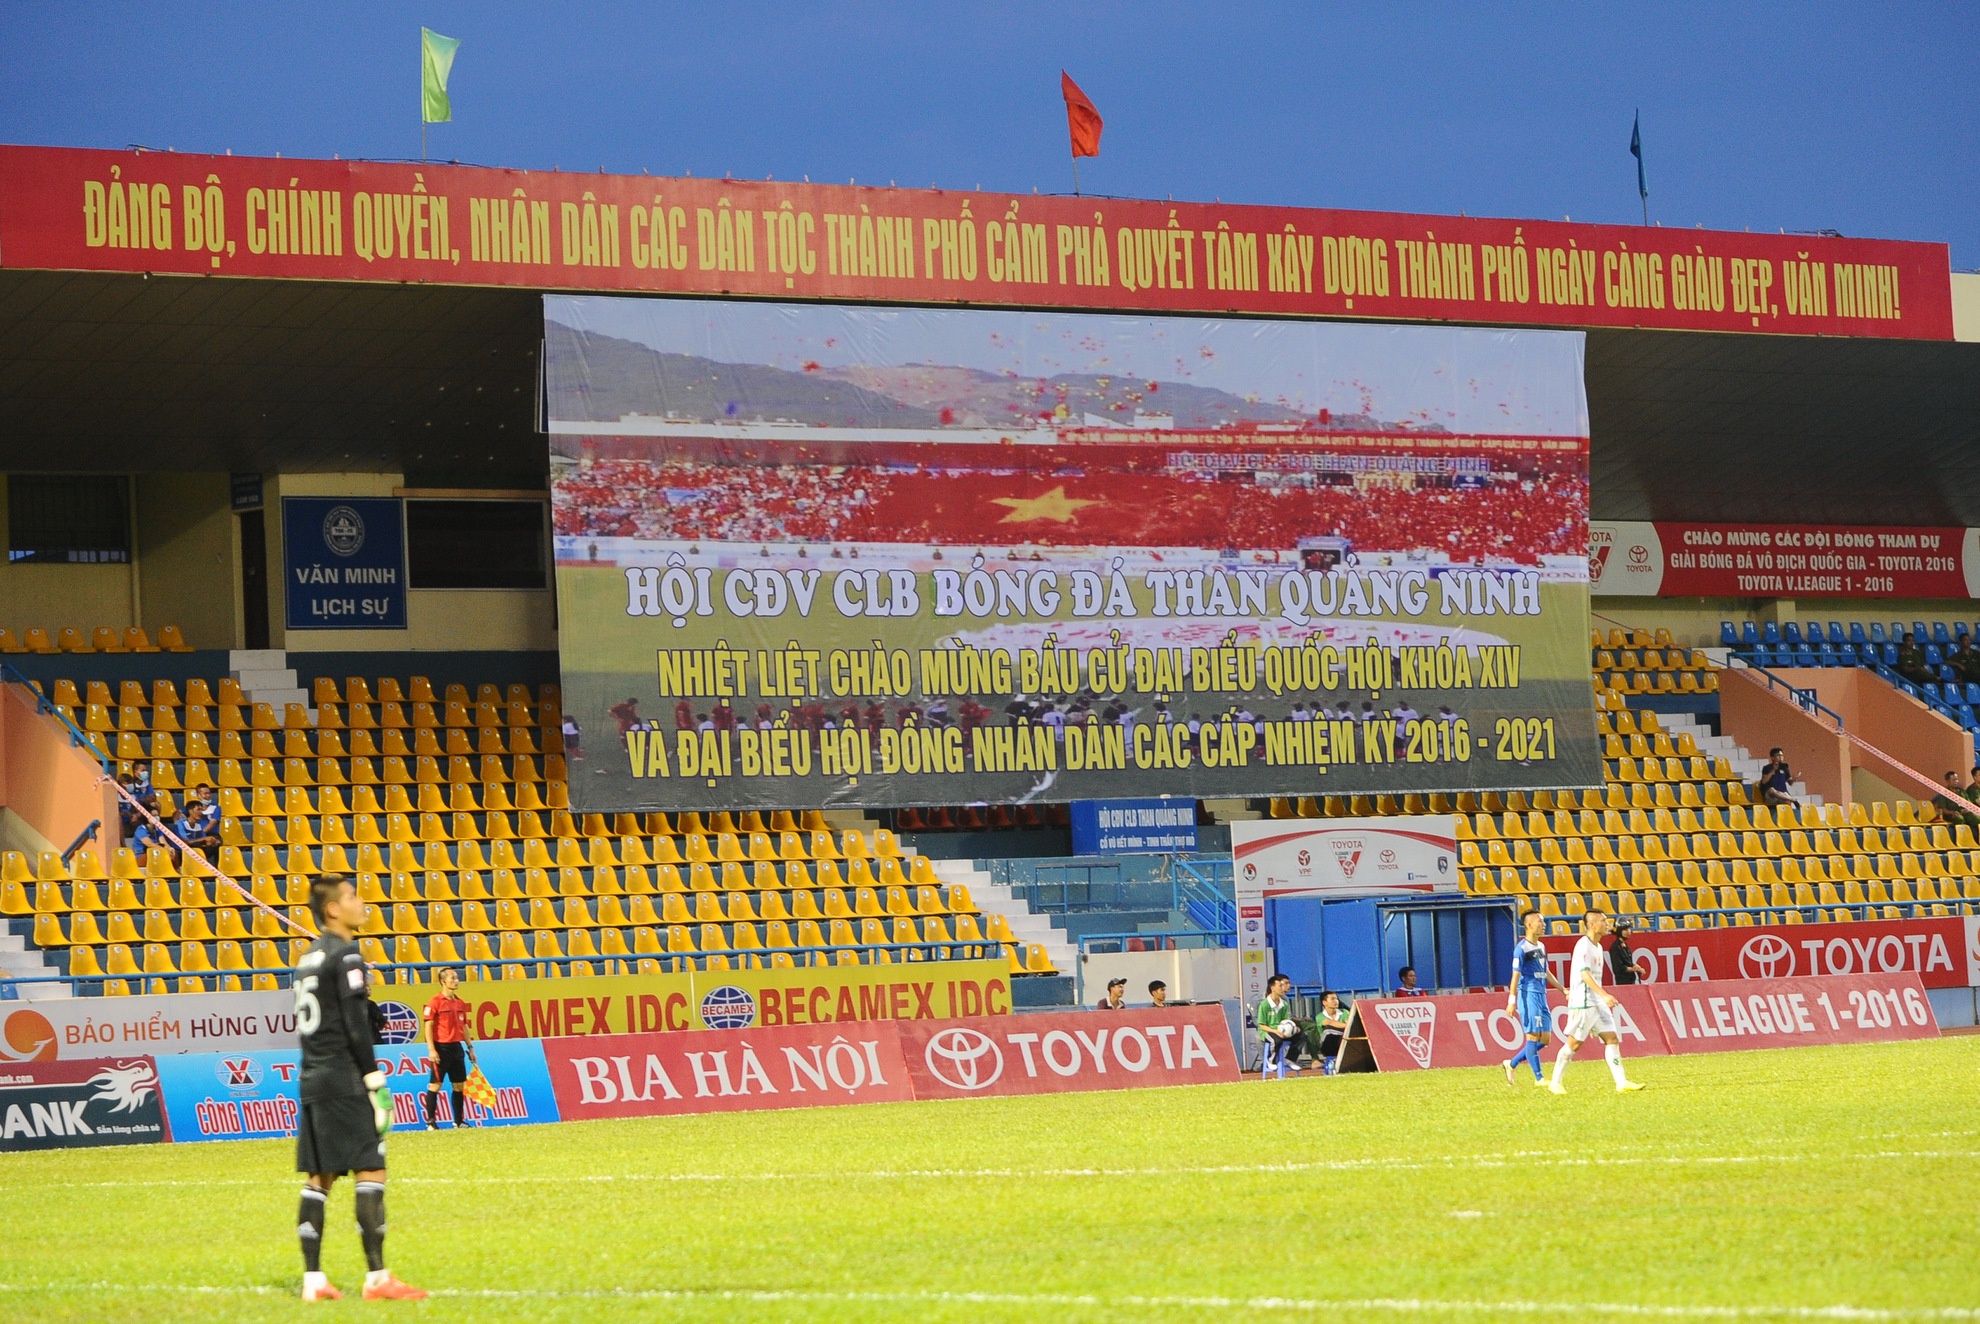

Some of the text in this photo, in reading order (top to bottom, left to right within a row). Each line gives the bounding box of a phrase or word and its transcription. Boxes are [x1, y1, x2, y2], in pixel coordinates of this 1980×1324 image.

[84, 165, 1901, 327] ĐẢNG BỘ, CHÍNH QUYỀN, NHÂN DÂN CÁC DÂN TỘC THÀNH PHỐ CẨM PHẢ QUYẾT TÂM XÂY DỰNG THÀNH PHỐ NGÀY CÀNG GIÀU ĐẸP, VĂN MINH!
[1683, 528, 1941, 551] CHÀO MỪNG CÁC ĐỘI BÓNG THAM DỰ
[296, 563, 396, 584] VĂN MINH
[1671, 549, 1696, 568] GIẢI
[1699, 550, 1733, 569] BÓNG
[1736, 551, 1753, 569] ĐÁ
[1756, 551, 1773, 569] VÔ
[1776, 554, 1806, 572] ĐỊCH
[1810, 550, 1843, 571] QUỐC
[1846, 556, 1867, 570] GIA
[1878, 556, 1923, 571] TOYOTA
[1926, 557, 1955, 571] 2016
[624, 552, 1542, 627] HỘI CĐV CLB BÓNG ĐÁ THAN QUẢNG NINH
[1737, 575, 1783, 591] TOYOTA
[1786, 576, 1841, 591] V.LEAGUE
[1845, 577, 1851, 591] 1
[1864, 577, 1894, 591] 2016
[312, 597, 389, 619] LỊCH SỰ
[656, 628, 1521, 707] NHIỆT LIỆT CHÀO MỪNG BẦU CỬ ĐẠI BIỂU QUỐC HỘI KHÓA XIV
[625, 705, 1557, 788] VÀ ĐẠI BIỂU HỘI ĐỒNG NHÂN DÂN CÁC CẤP NHIỆM KỲ 2016 - 2021
[1332, 841, 1363, 849] TOYOTA
[1801, 934, 1954, 975] TOYOTA
[626, 992, 690, 1033] IDC
[702, 1004, 754, 1016] BECAMEX
[759, 979, 1007, 1026] BECAMEX IDC
[1380, 1007, 1432, 1019] TOYOTA
[1660, 993, 1815, 1039] V.LEAGUE
[1817, 987, 1928, 1030] 1-2016
[65, 1017, 115, 1045] BẢO
[123, 1011, 181, 1042] HIỂM
[191, 1013, 257, 1038] HÙNG
[569, 1025, 1218, 1104] BIA HÀ NỘI TOYOTA
[0, 1100, 94, 1139] ANK
[196, 1096, 241, 1134] CÔNG
[241, 1094, 298, 1137] NGHIỆP
